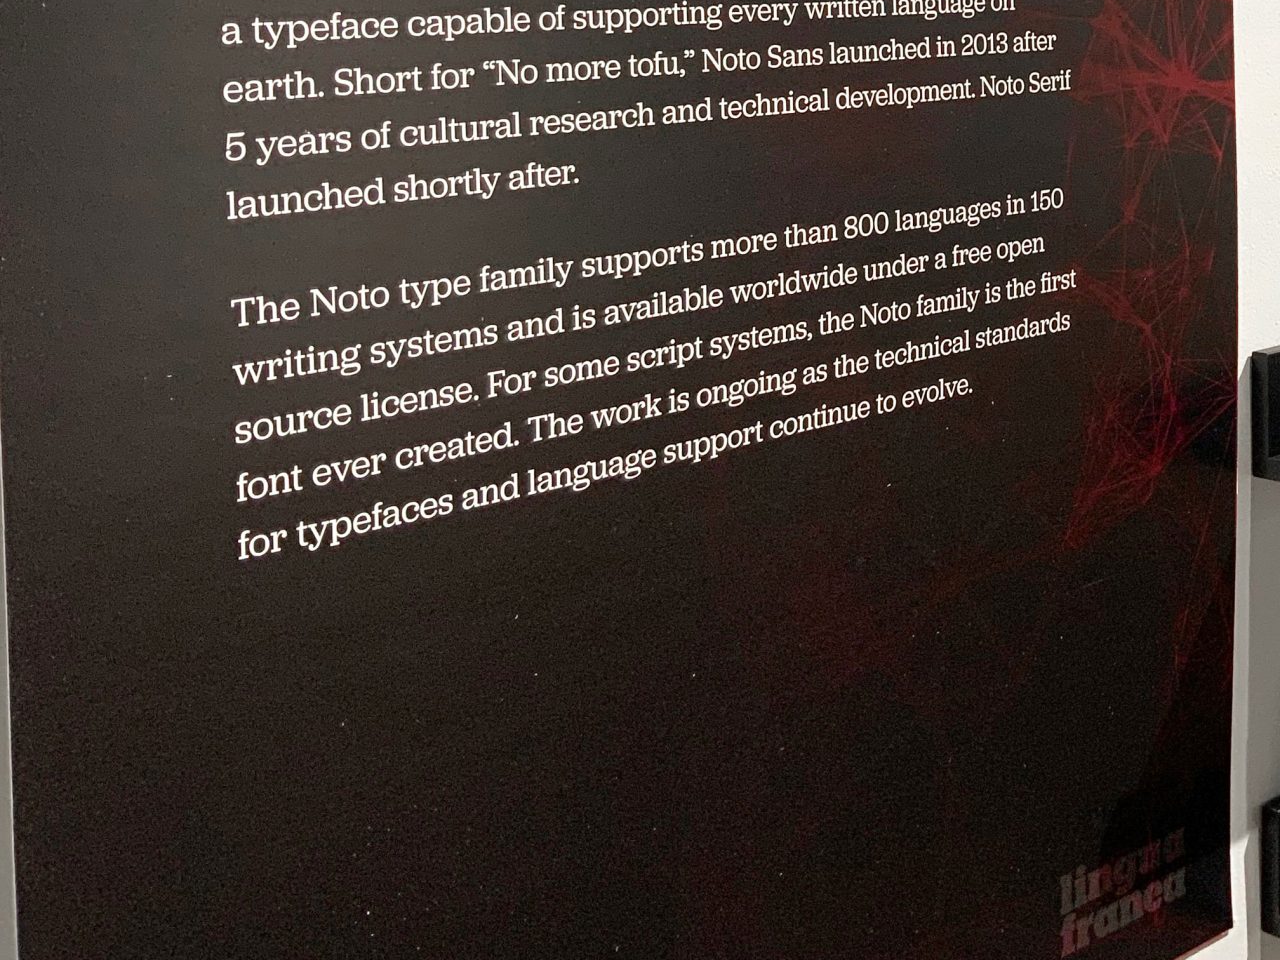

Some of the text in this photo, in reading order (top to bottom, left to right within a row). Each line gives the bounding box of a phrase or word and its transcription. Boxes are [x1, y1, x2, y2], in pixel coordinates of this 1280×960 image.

[221, 22, 244, 46] a
[250, 11, 399, 51] typeface
[407, 6, 531, 42] capable
[538, 4, 567, 32] of
[572, 0, 724, 35] supporting
[728, 2, 799, 27] every
[222, 30, 1057, 104] earth. Short for “No more tofu,” Noto Sans launched in 2013 after
[225, 68, 1072, 167] 5 years of cultural research and technical development. Noto Serif
[225, 161, 580, 221] launched shortly after.
[230, 187, 1064, 328] The Noto type family supports more than 800 languages in 150
[234, 268, 1077, 445] source license. For some script systems, the Noto family is the first
[235, 311, 1071, 503] font ever created. The work is ongoing as the technical standards
[237, 377, 973, 561] for typefaces and language support continue to evolve.
[1060, 867, 1187, 959] franca
